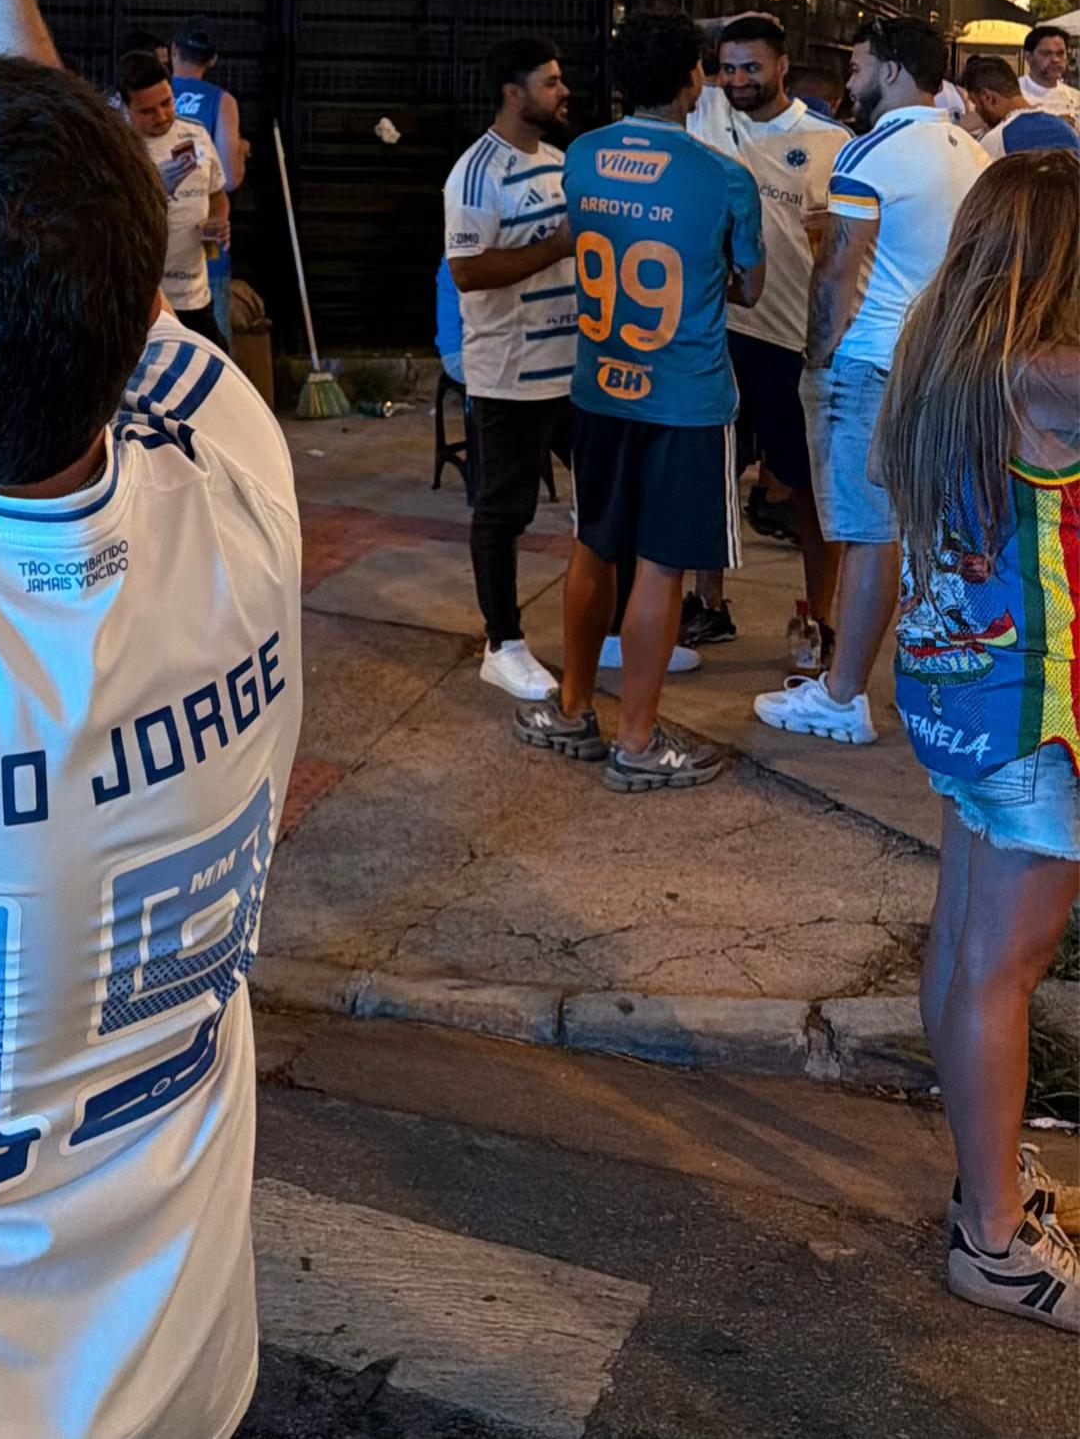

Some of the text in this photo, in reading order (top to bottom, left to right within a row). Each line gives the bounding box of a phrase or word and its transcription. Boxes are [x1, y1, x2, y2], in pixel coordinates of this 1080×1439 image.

[600, 154, 658, 177] Vilma
[579, 196, 674, 222] ARROYO JR
[576, 230, 684, 352] 99
[605, 367, 643, 393] BH
[25, 557, 129, 593] JAMAIS VENCIDO
[54, 539, 129, 576] COMBATIDO
[90, 631, 286, 806] JORGE
[909, 713, 992, 766] FAVELA
[658, 749, 687, 769] N
